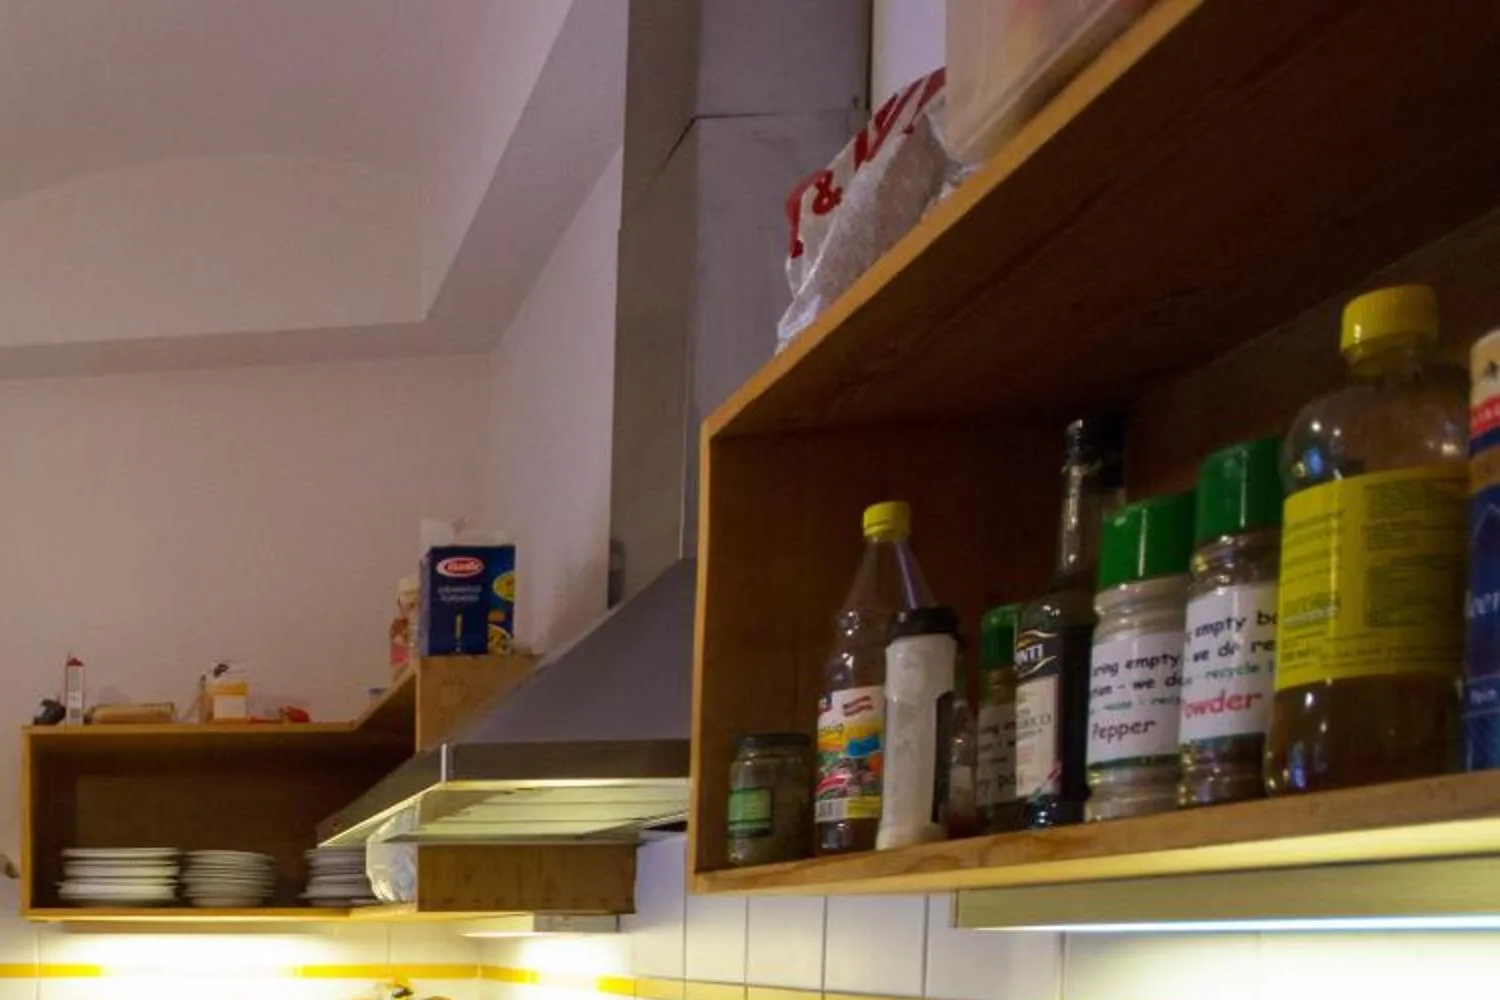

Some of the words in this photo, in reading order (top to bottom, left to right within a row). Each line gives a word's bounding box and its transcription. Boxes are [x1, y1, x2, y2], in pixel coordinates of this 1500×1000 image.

[1251, 639, 1276, 653] re
[1125, 652, 1181, 672] empty
[1133, 679, 1156, 691] we
[1183, 690, 1263, 722] owder
